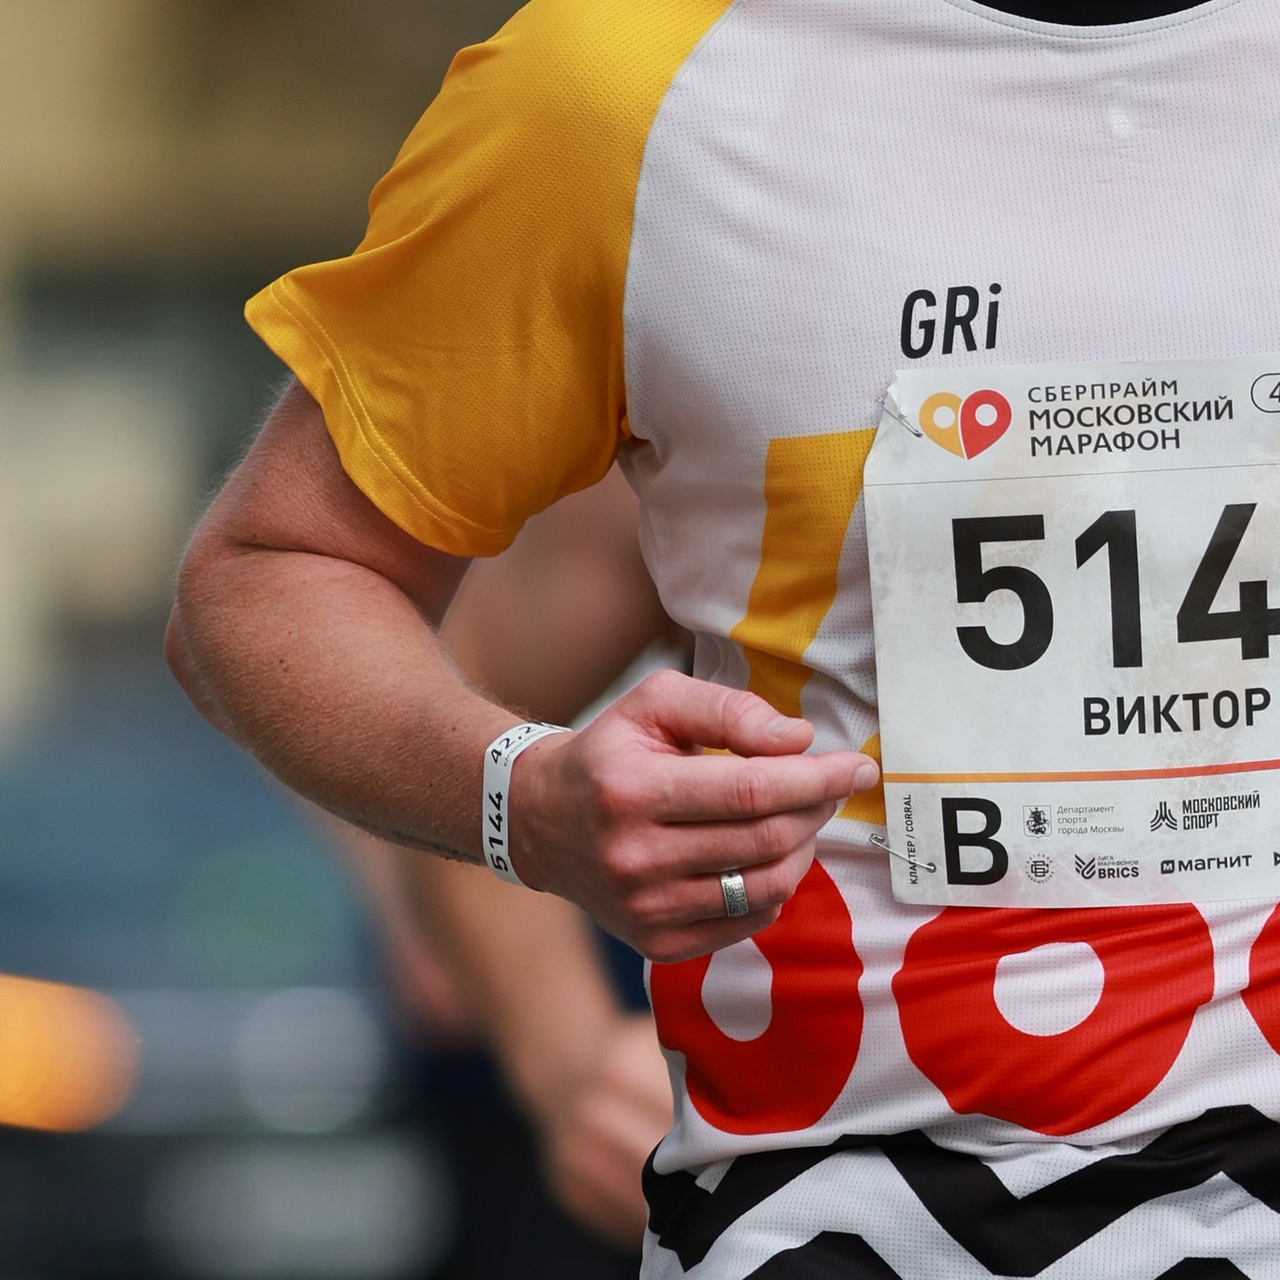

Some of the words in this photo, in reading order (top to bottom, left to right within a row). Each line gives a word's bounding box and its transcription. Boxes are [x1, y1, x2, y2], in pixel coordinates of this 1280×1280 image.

[900, 282, 1002, 360] GRi
[1027, 377, 1179, 404] СБЕРПРАЙМ
[1028, 395, 1235, 431] МОСКОВСКИЙ
[1030, 428, 1181, 457] МАРАФОН
[1083, 687, 1272, 736] ВИКТОР
[490, 725, 537, 764] 42.2
[903, 793, 914, 832] CORRAL
[1057, 805, 1115, 815] Департамент
[1182, 790, 1261, 814] МОСКОВСКИЙ
[488, 791, 509, 872] 5144
[1057, 816, 1088, 825] спорта
[1058, 826, 1088, 835] города
[1090, 825, 1125, 834] Москвы
[1183, 812, 1220, 831] СПОРТ
[1097, 866, 1140, 879] BRICS
